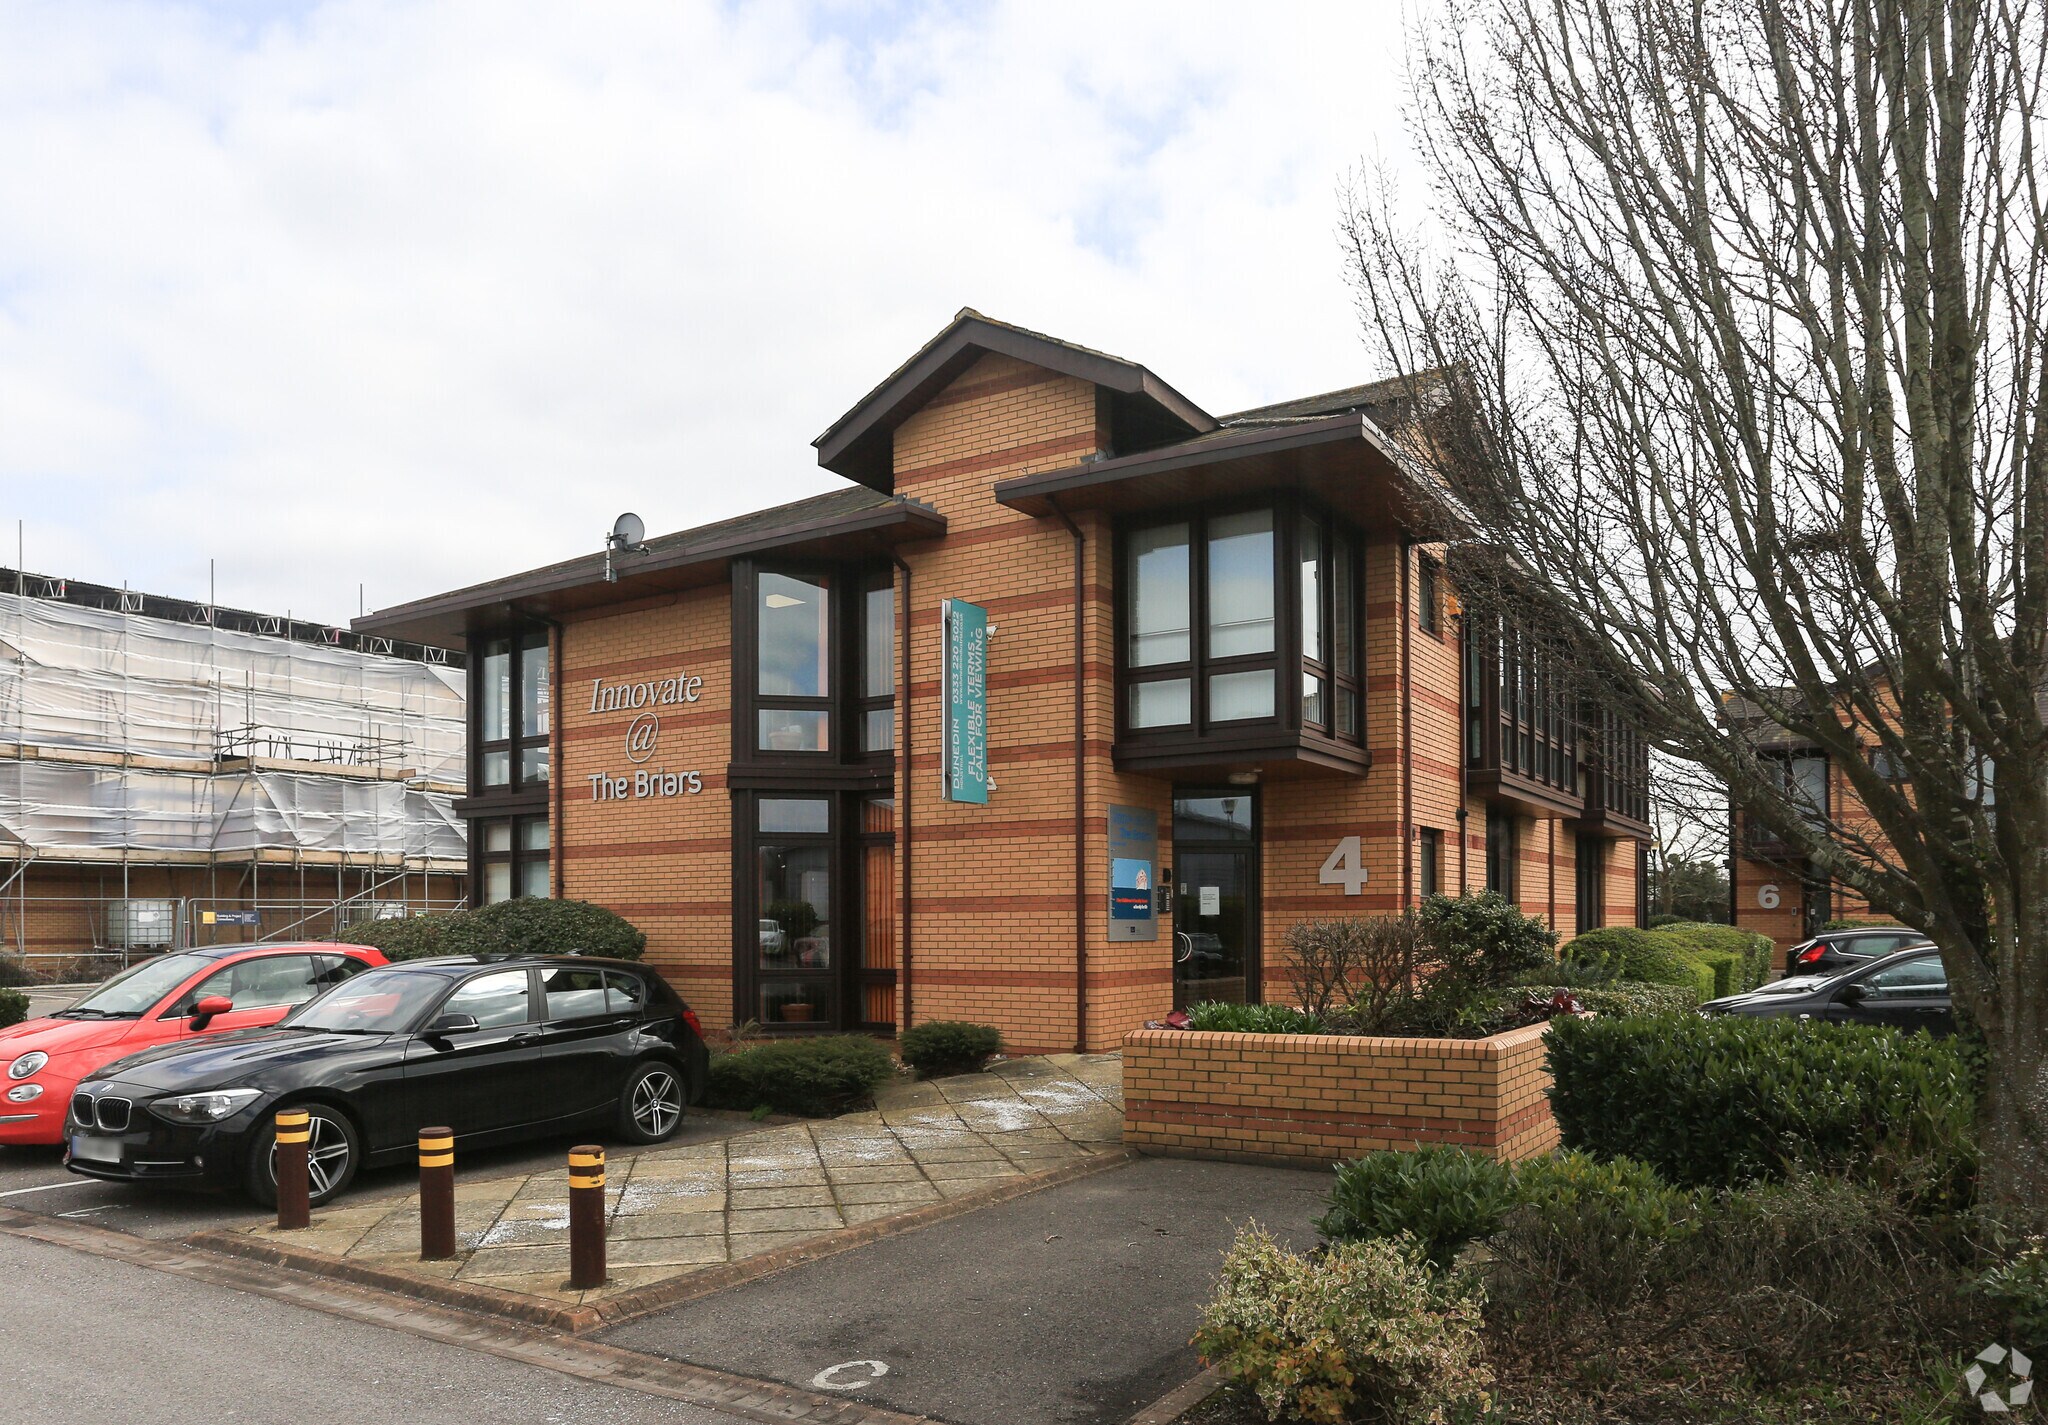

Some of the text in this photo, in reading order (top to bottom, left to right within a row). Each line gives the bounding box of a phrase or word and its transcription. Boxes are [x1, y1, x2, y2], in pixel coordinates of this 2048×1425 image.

[588, 671, 702, 713] Innovate
[967, 642, 975, 695] TERMS
[975, 627, 984, 783] CALL FOR VIEWING
[626, 712, 659, 763] @
[967, 700, 976, 776] FLEXIBLE
[588, 767, 702, 800] The Briars
[1319, 836, 1368, 895] 4
[1758, 884, 1780, 909] 6
